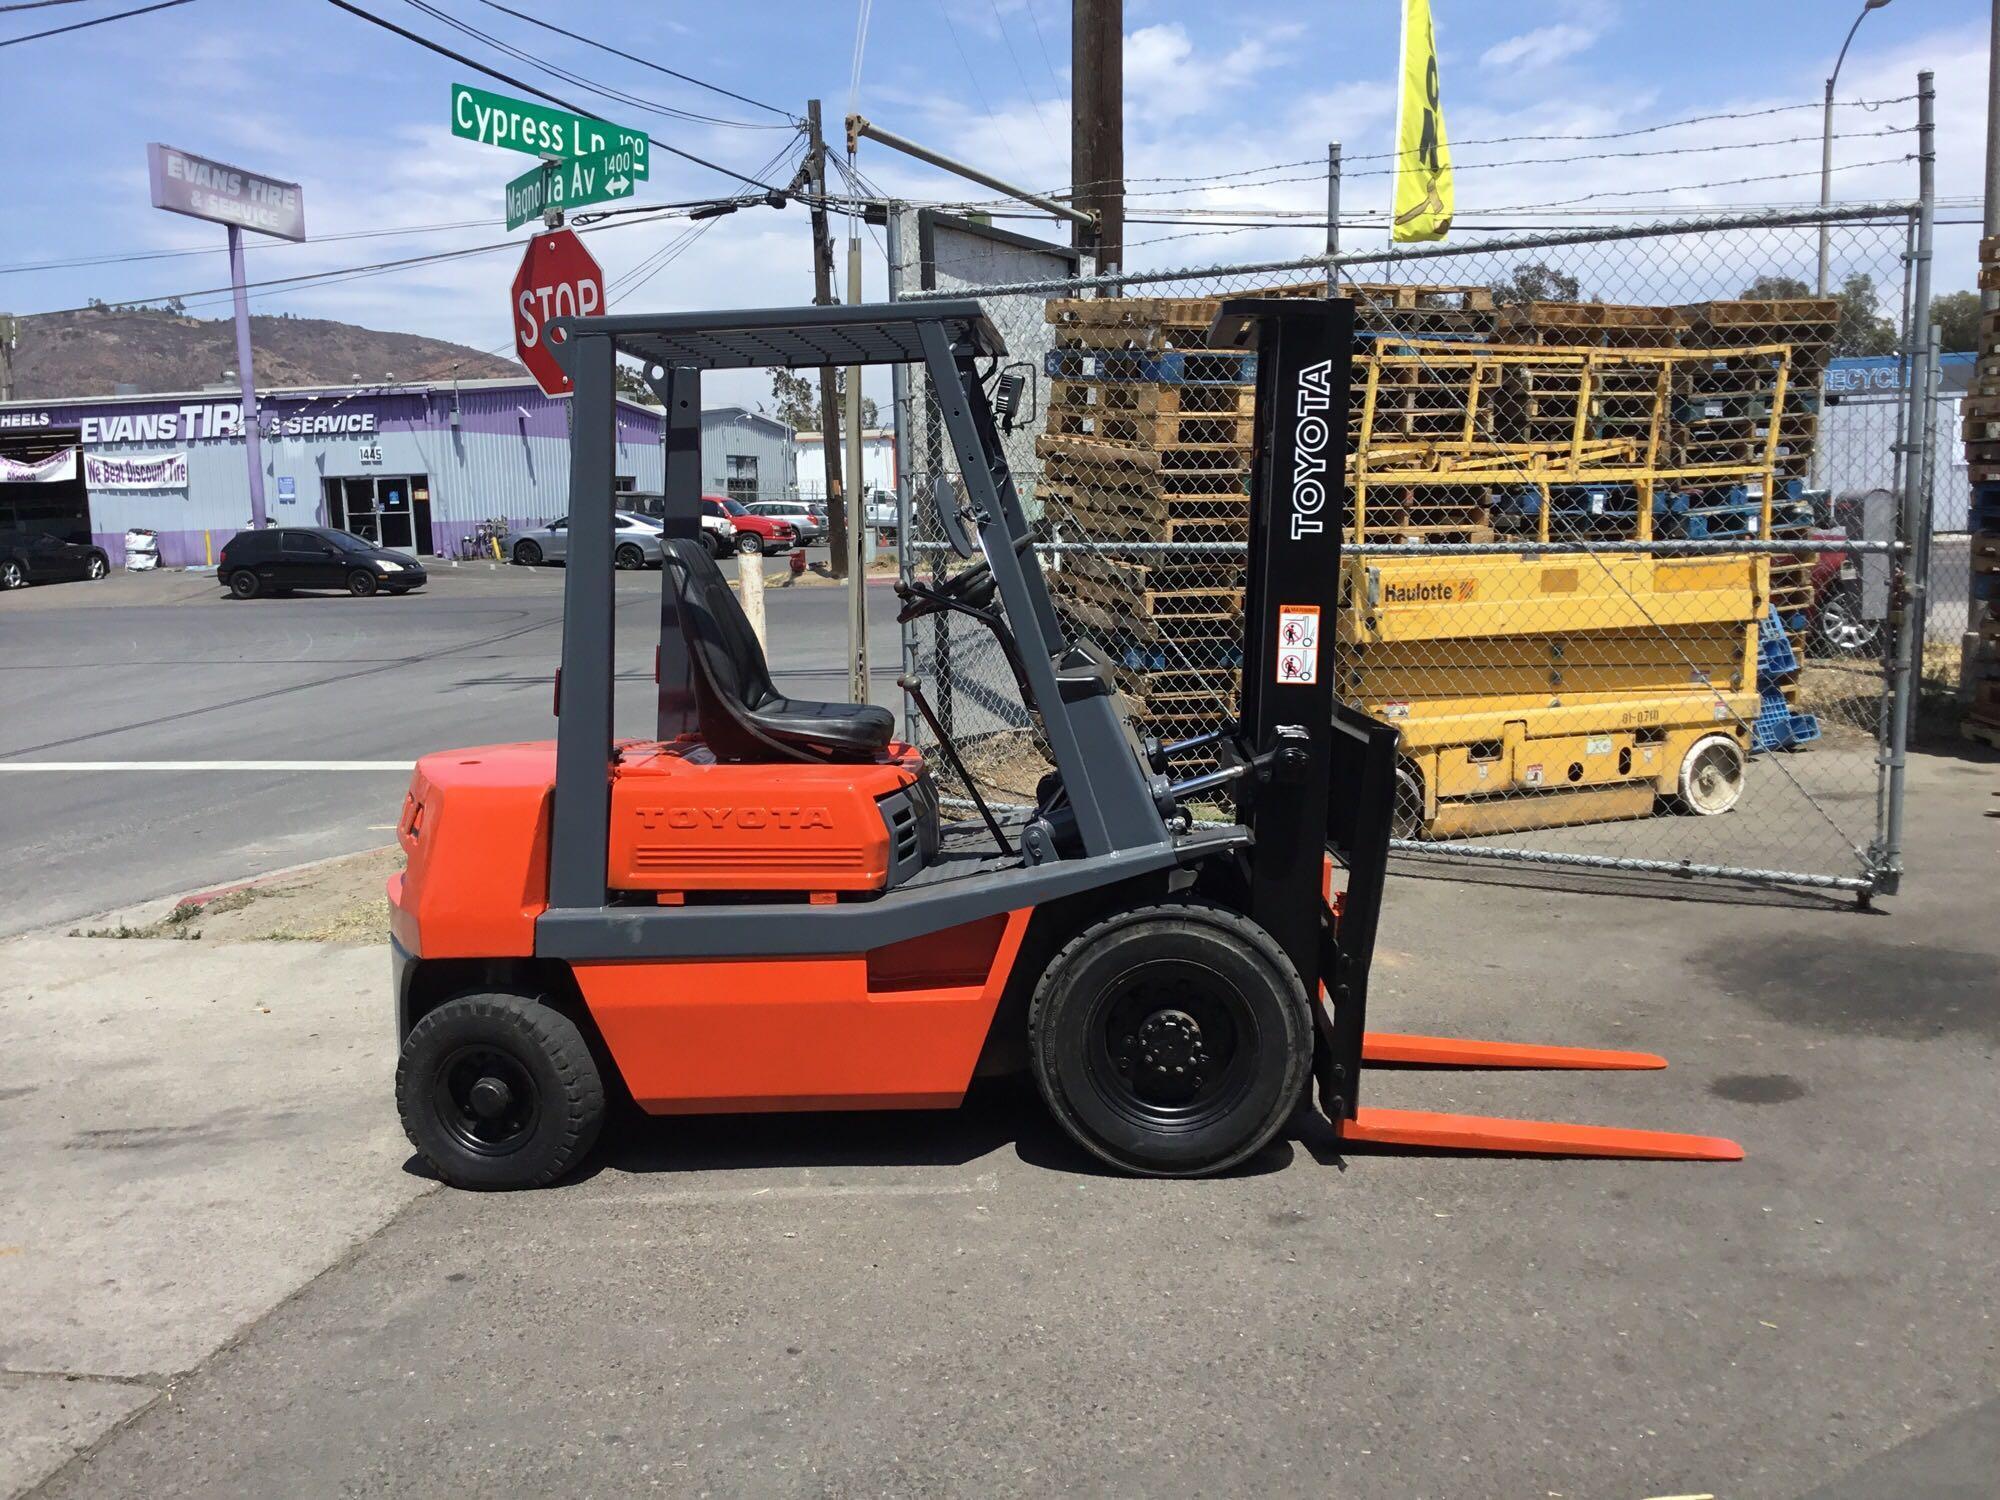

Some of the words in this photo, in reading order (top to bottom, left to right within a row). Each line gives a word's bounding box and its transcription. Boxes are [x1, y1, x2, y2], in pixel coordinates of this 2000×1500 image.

[457, 91, 564, 152] Cypress
[574, 121, 606, 156] Ln
[168, 154, 242, 197] EVANS
[247, 178, 297, 211] TIRE
[507, 168, 563, 223] Magnolia
[571, 162, 596, 198] Av
[604, 152, 630, 176] 1400
[191, 190, 201, 209] &
[207, 194, 279, 228] SERVICE
[518, 278, 599, 348] STOP
[1823, 366, 1943, 391] RECYCLI
[0, 412, 50, 428] HEELS
[81, 413, 177, 443] EVANS
[288, 413, 374, 435] SERVICE
[359, 448, 382, 460] 1445
[1291, 359, 1332, 540] TOYOTA
[87, 459, 101, 484] We
[103, 460, 125, 483] Beat
[126, 460, 166, 483] Discount
[167, 457, 186, 482] Tire
[1384, 583, 1453, 602] Haulotte
[636, 807, 834, 830] TOYOTA
